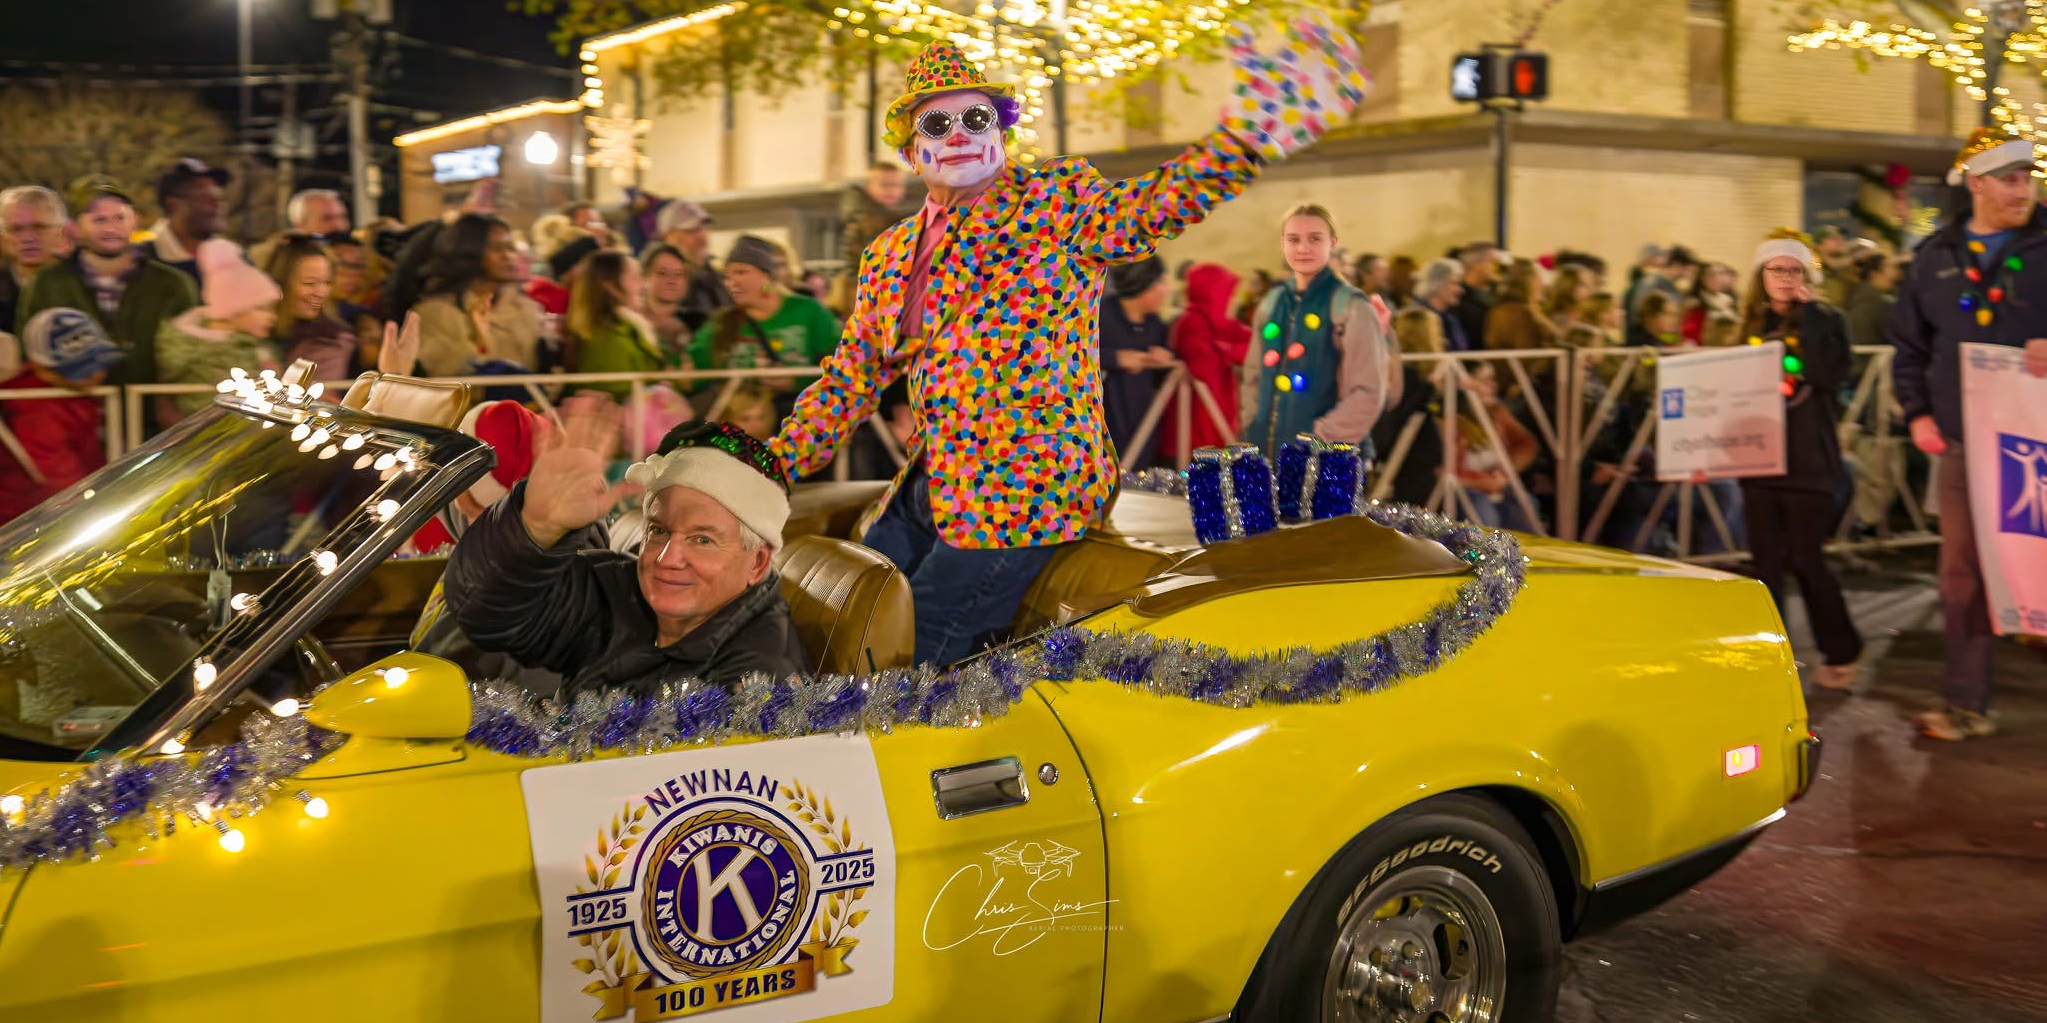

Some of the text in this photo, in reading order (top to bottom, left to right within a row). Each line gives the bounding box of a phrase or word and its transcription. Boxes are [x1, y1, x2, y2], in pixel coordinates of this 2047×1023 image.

[644, 768, 779, 818] NEWNAN
[667, 823, 779, 869] KIWANIS
[693, 845, 764, 942] K
[821, 858, 875, 886] 2025
[567, 897, 627, 927] 1925
[656, 869, 796, 965] INTERNATIONAL
[654, 968, 796, 1014] 100 YEARS
